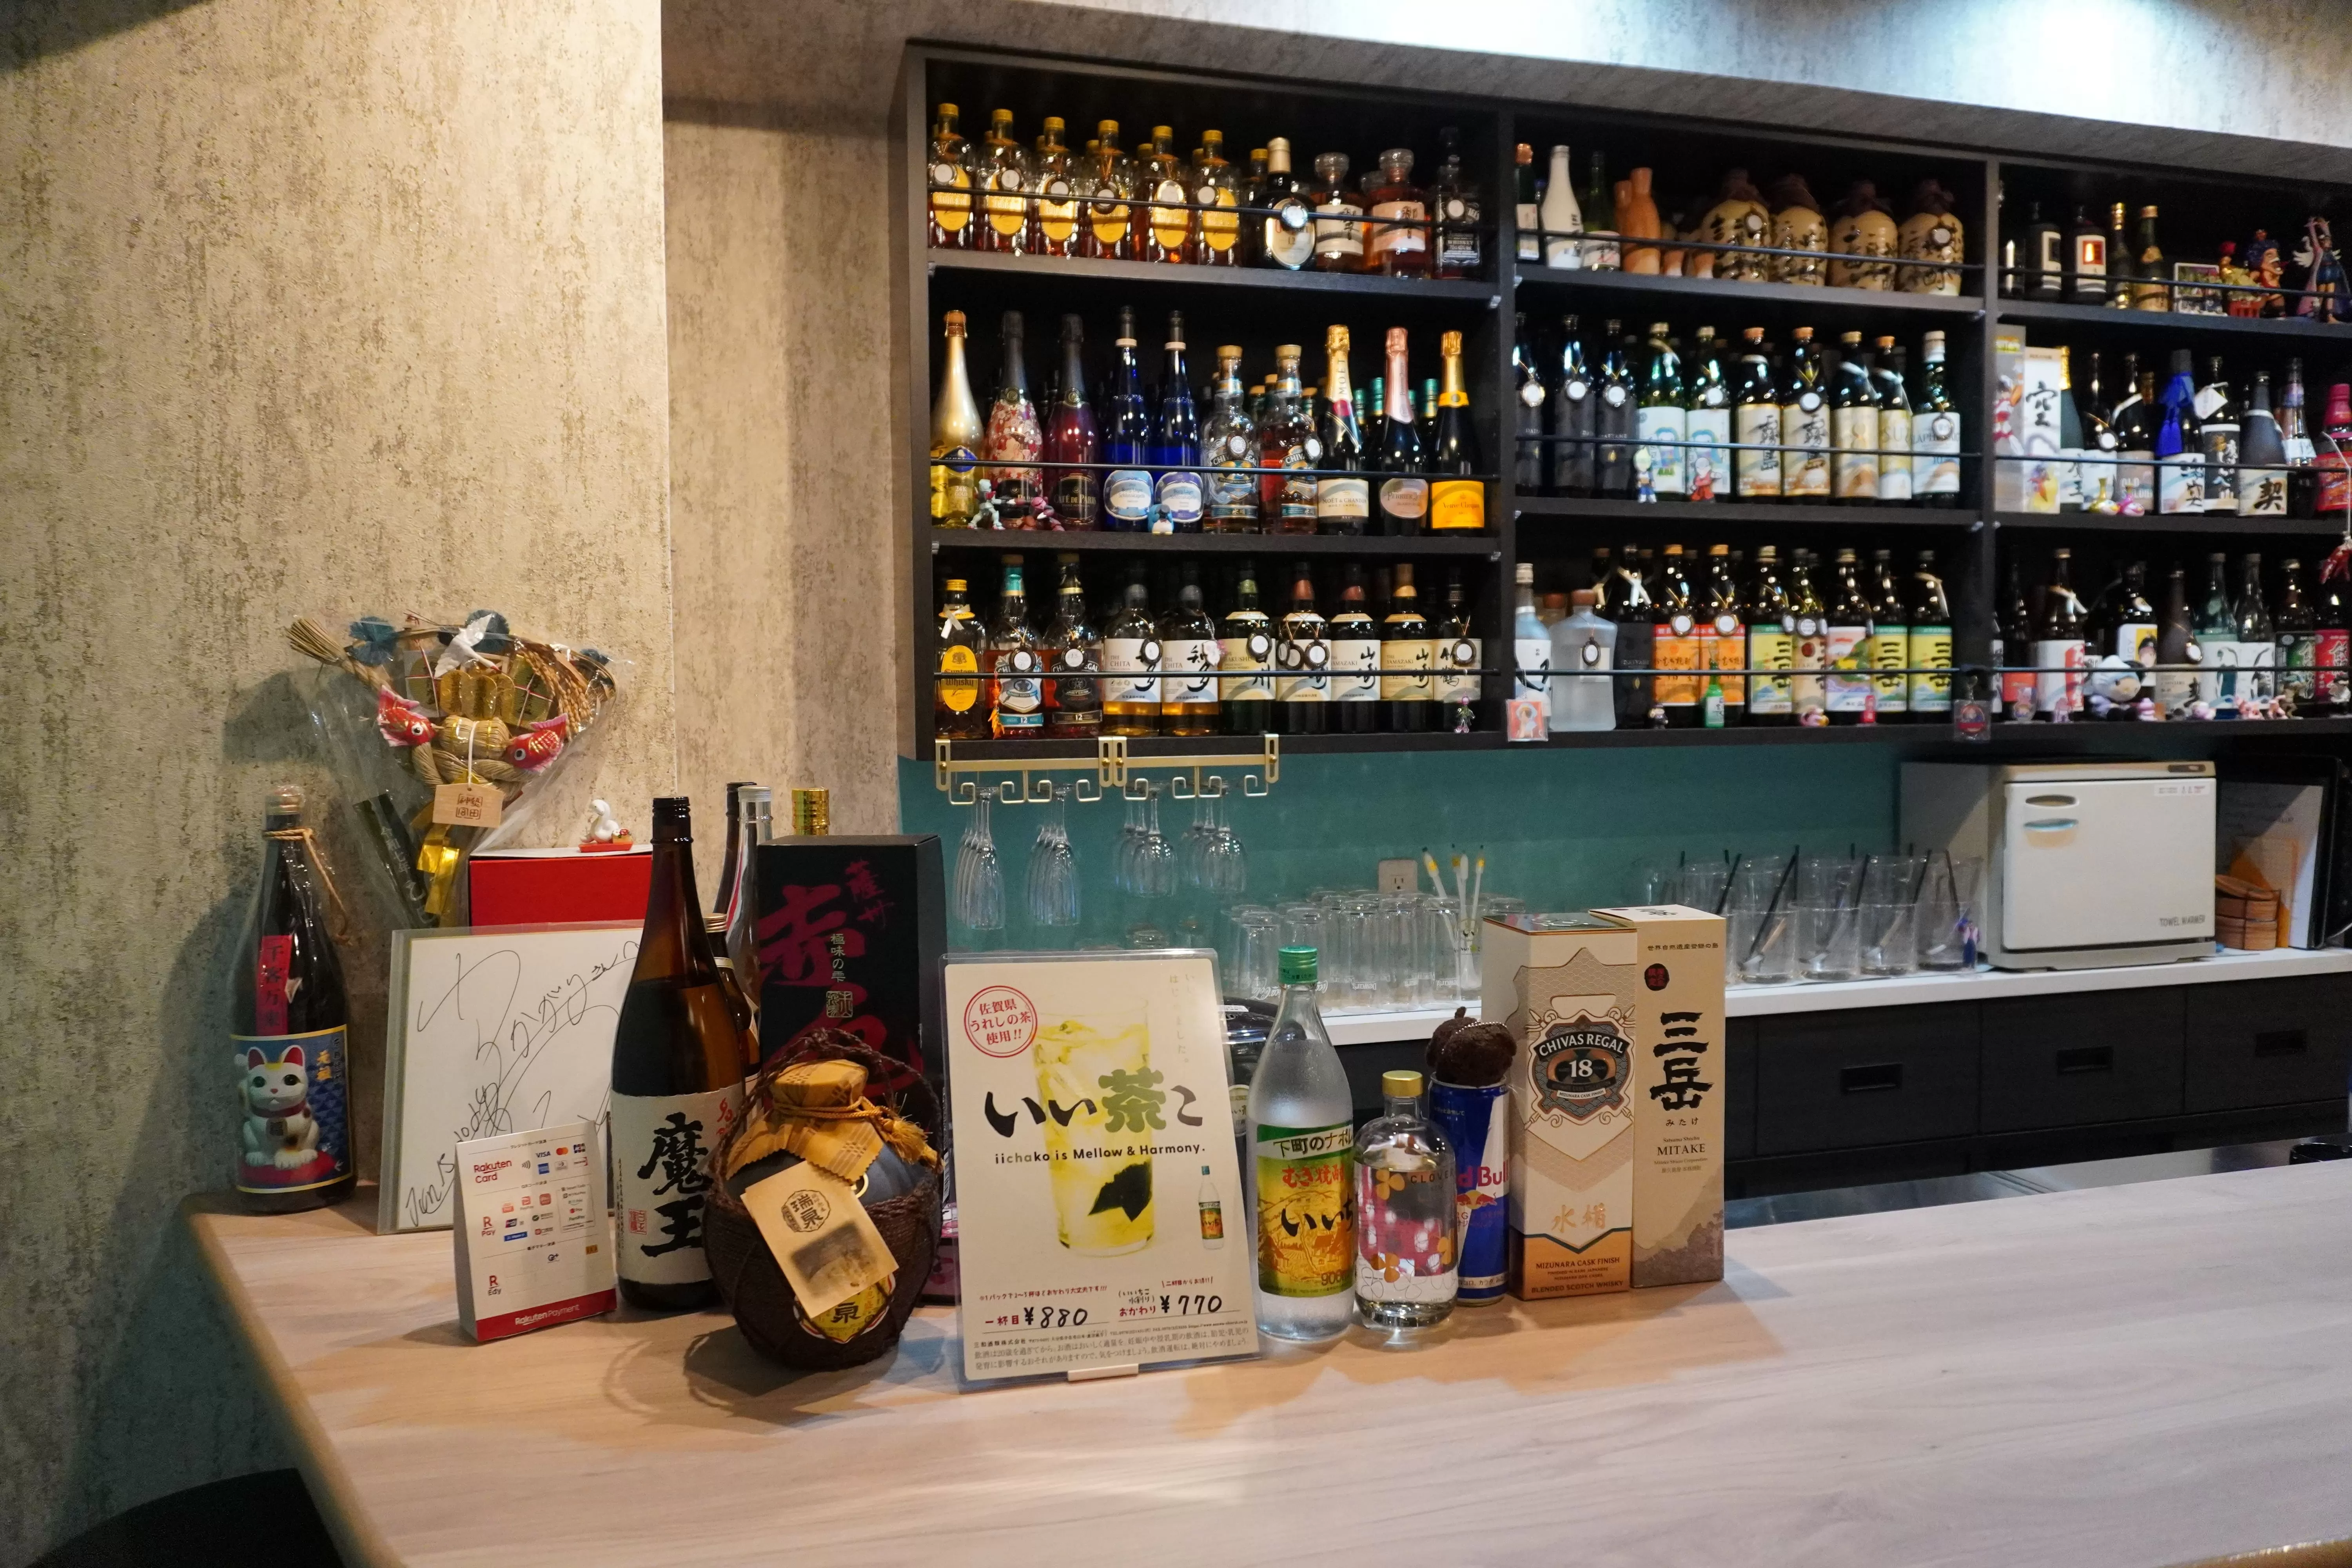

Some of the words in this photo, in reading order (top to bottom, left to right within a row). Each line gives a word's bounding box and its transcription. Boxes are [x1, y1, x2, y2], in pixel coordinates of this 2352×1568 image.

[980, 998, 1017, 1016] 佐賀県
[970, 1011, 1032, 1032] うれしの茶
[1539, 1033, 1584, 1056] CHIVAS
[1586, 1033, 1624, 1054] REGAL
[1569, 1059, 1593, 1078] 18
[1650, 1011, 1713, 1112] 三岳
[984, 1067, 1203, 1138] いい茶こ
[1666, 1116, 1699, 1127] みたけ
[995, 1152, 1050, 1164] iichako
[1056, 1150, 1067, 1160] is
[1073, 1147, 1123, 1159] Mellow
[1127, 1146, 1136, 1156] &
[1140, 1144, 1205, 1156] Harmony.
[1657, 1143, 1706, 1156] MITAKE
[474, 1160, 512, 1173] Rakuten
[475, 1172, 498, 1183] Card
[637, 1112, 714, 1258] 魔王
[790, 1194, 824, 1229] 瑞泉
[1536, 1260, 1575, 1270] MIZUNARA
[1577, 1258, 1595, 1267] CASK
[1597, 1256, 1620, 1265] FINISH
[1531, 1285, 1564, 1293] BLENDED
[1566, 1283, 1594, 1291] SCOTCH
[515, 1311, 548, 1325] Rakuten
[548, 1304, 580, 1318] Payment
[1119, 1305, 1156, 1317] おかわり
[1160, 1295, 1222, 1316] ¥770
[985, 1315, 1019, 1326] 一杯目
[1024, 1306, 1088, 1328] ¥880
